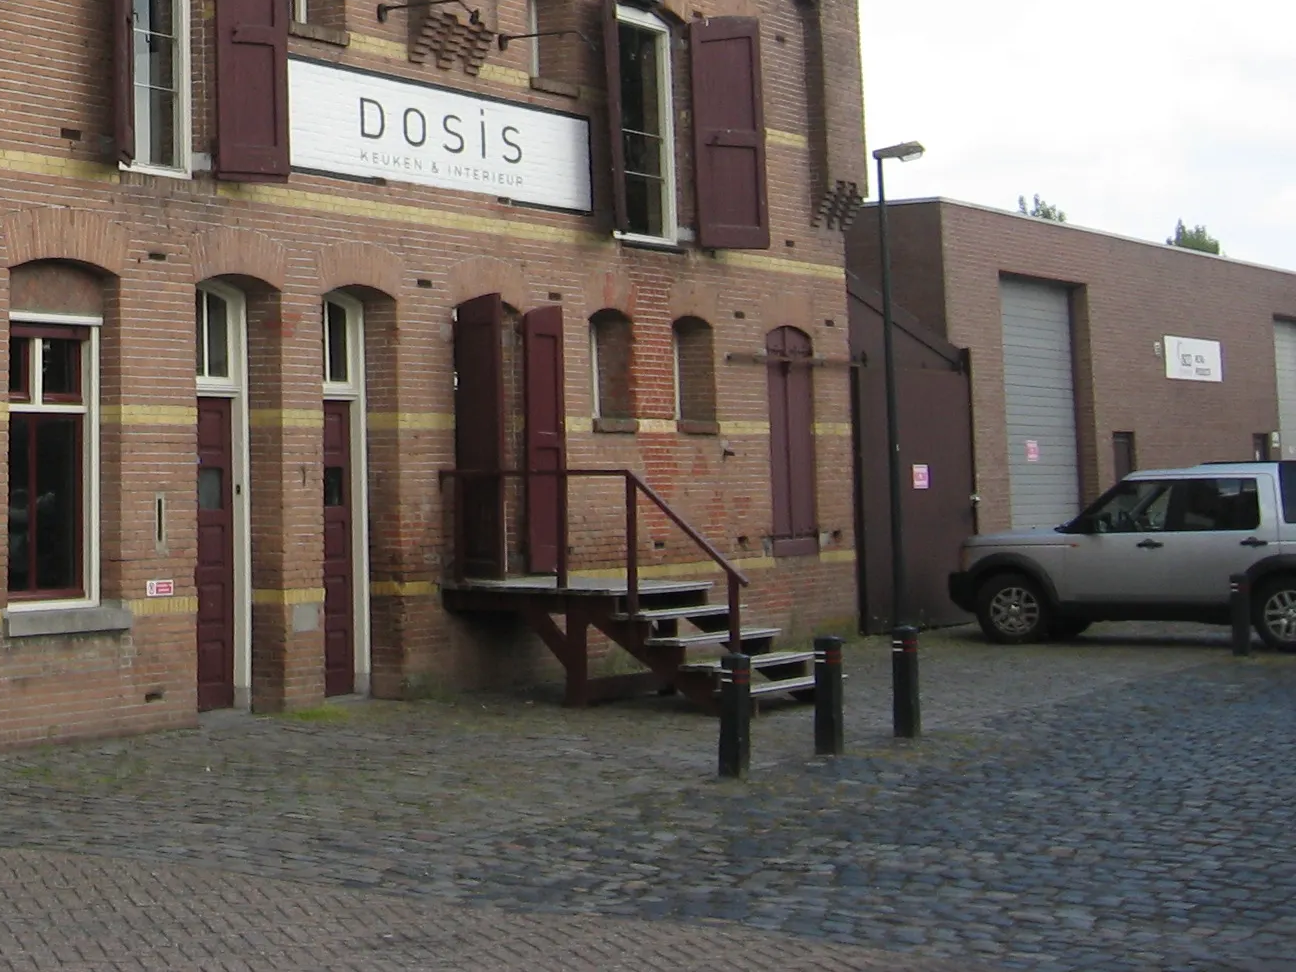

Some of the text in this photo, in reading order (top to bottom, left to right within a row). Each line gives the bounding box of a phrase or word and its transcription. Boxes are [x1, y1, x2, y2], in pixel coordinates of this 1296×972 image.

[360, 150, 524, 187] KEUKEN & INTERIEUR
